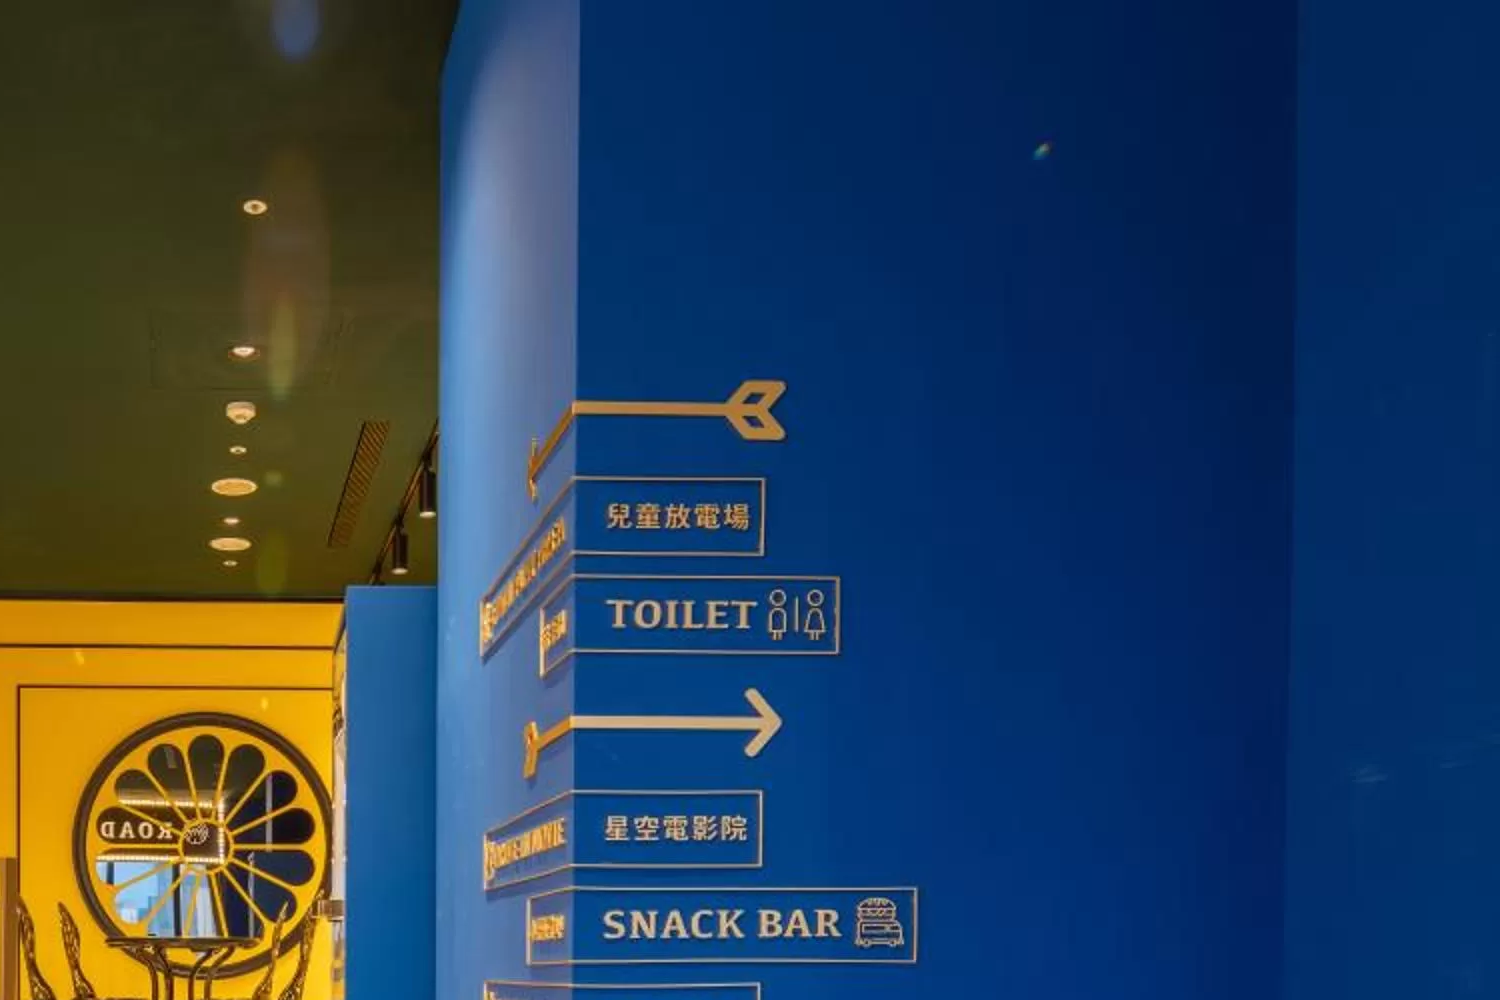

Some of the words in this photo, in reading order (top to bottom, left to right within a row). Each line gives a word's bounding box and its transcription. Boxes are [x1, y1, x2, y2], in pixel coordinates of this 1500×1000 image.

[606, 502, 750, 531] 兒童放電場
[605, 599, 758, 630] TOILET
[604, 815, 748, 842] 星空電影院
[602, 909, 746, 939] SNACK
[758, 909, 842, 938] BAR
